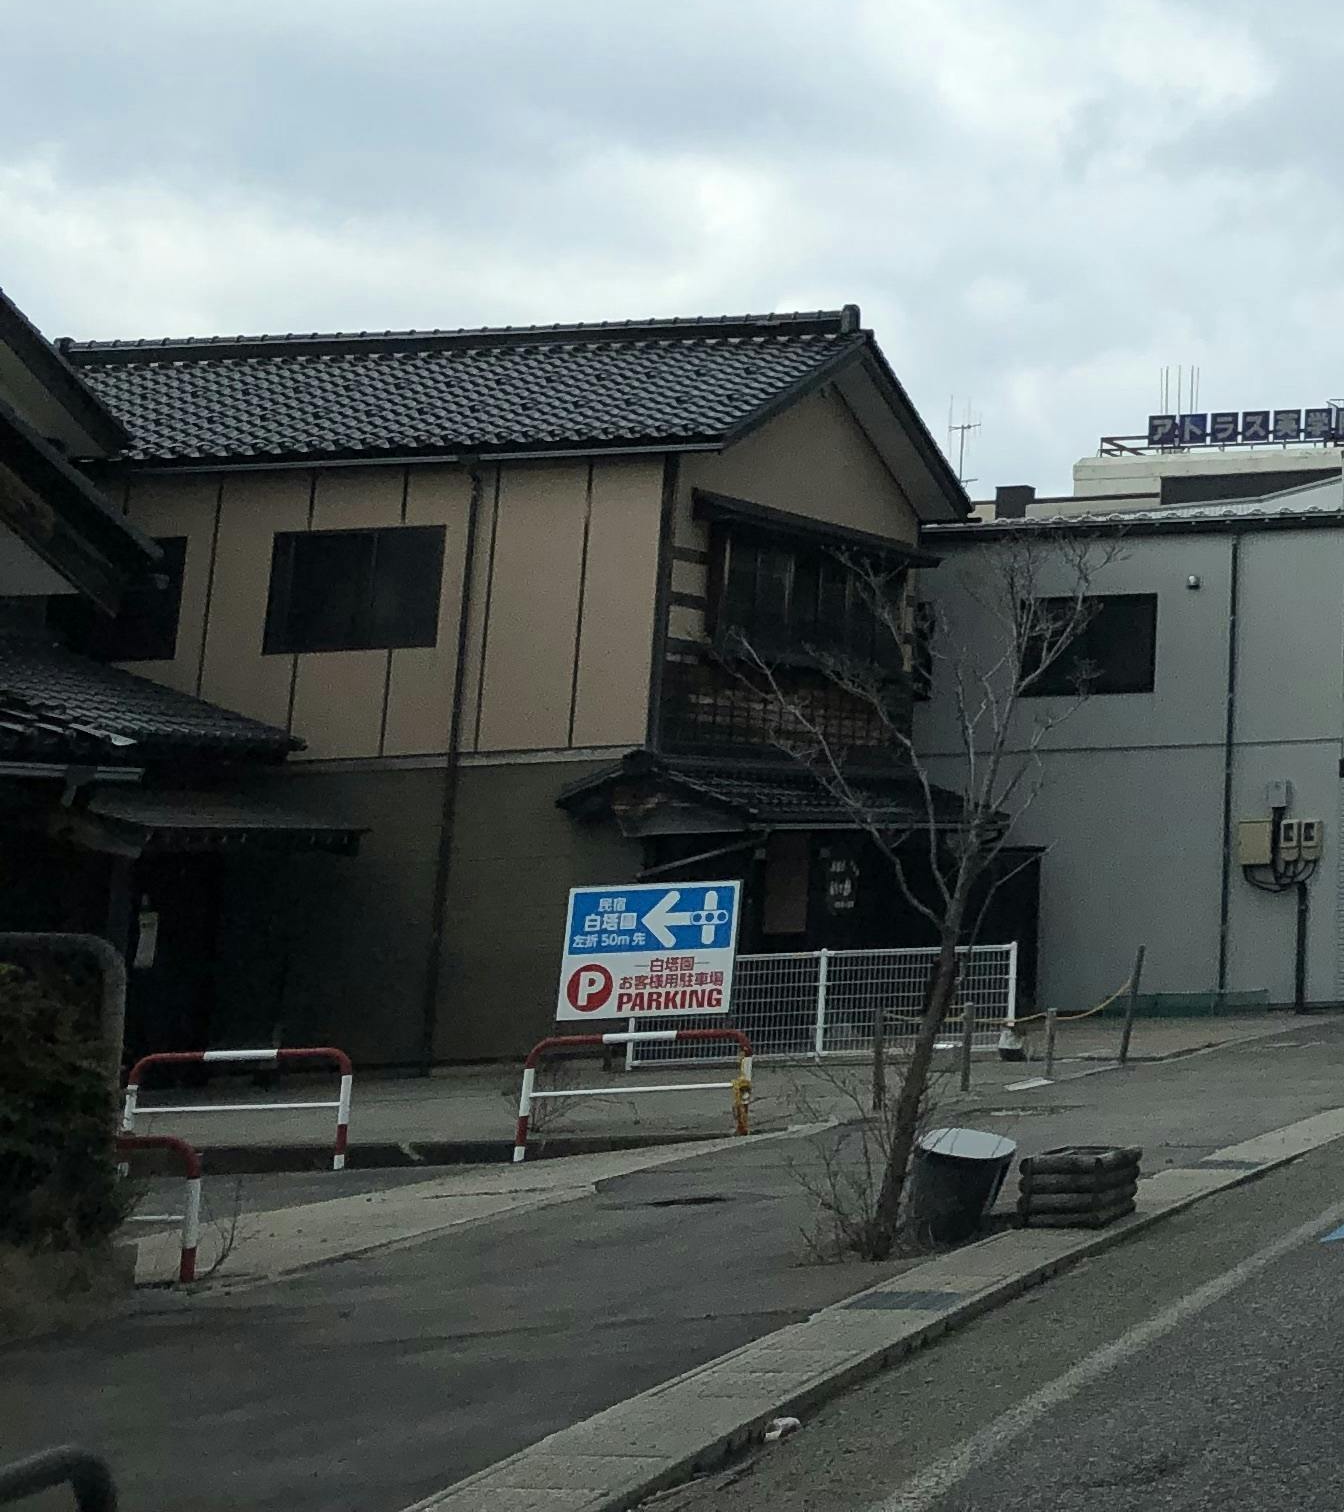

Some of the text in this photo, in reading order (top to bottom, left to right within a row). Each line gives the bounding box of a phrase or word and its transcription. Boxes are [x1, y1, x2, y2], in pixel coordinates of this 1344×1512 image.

[598, 897, 627, 912] 民宿
[619, 971, 724, 990] お客様用駐車場
[616, 988, 723, 1012] PARKING
